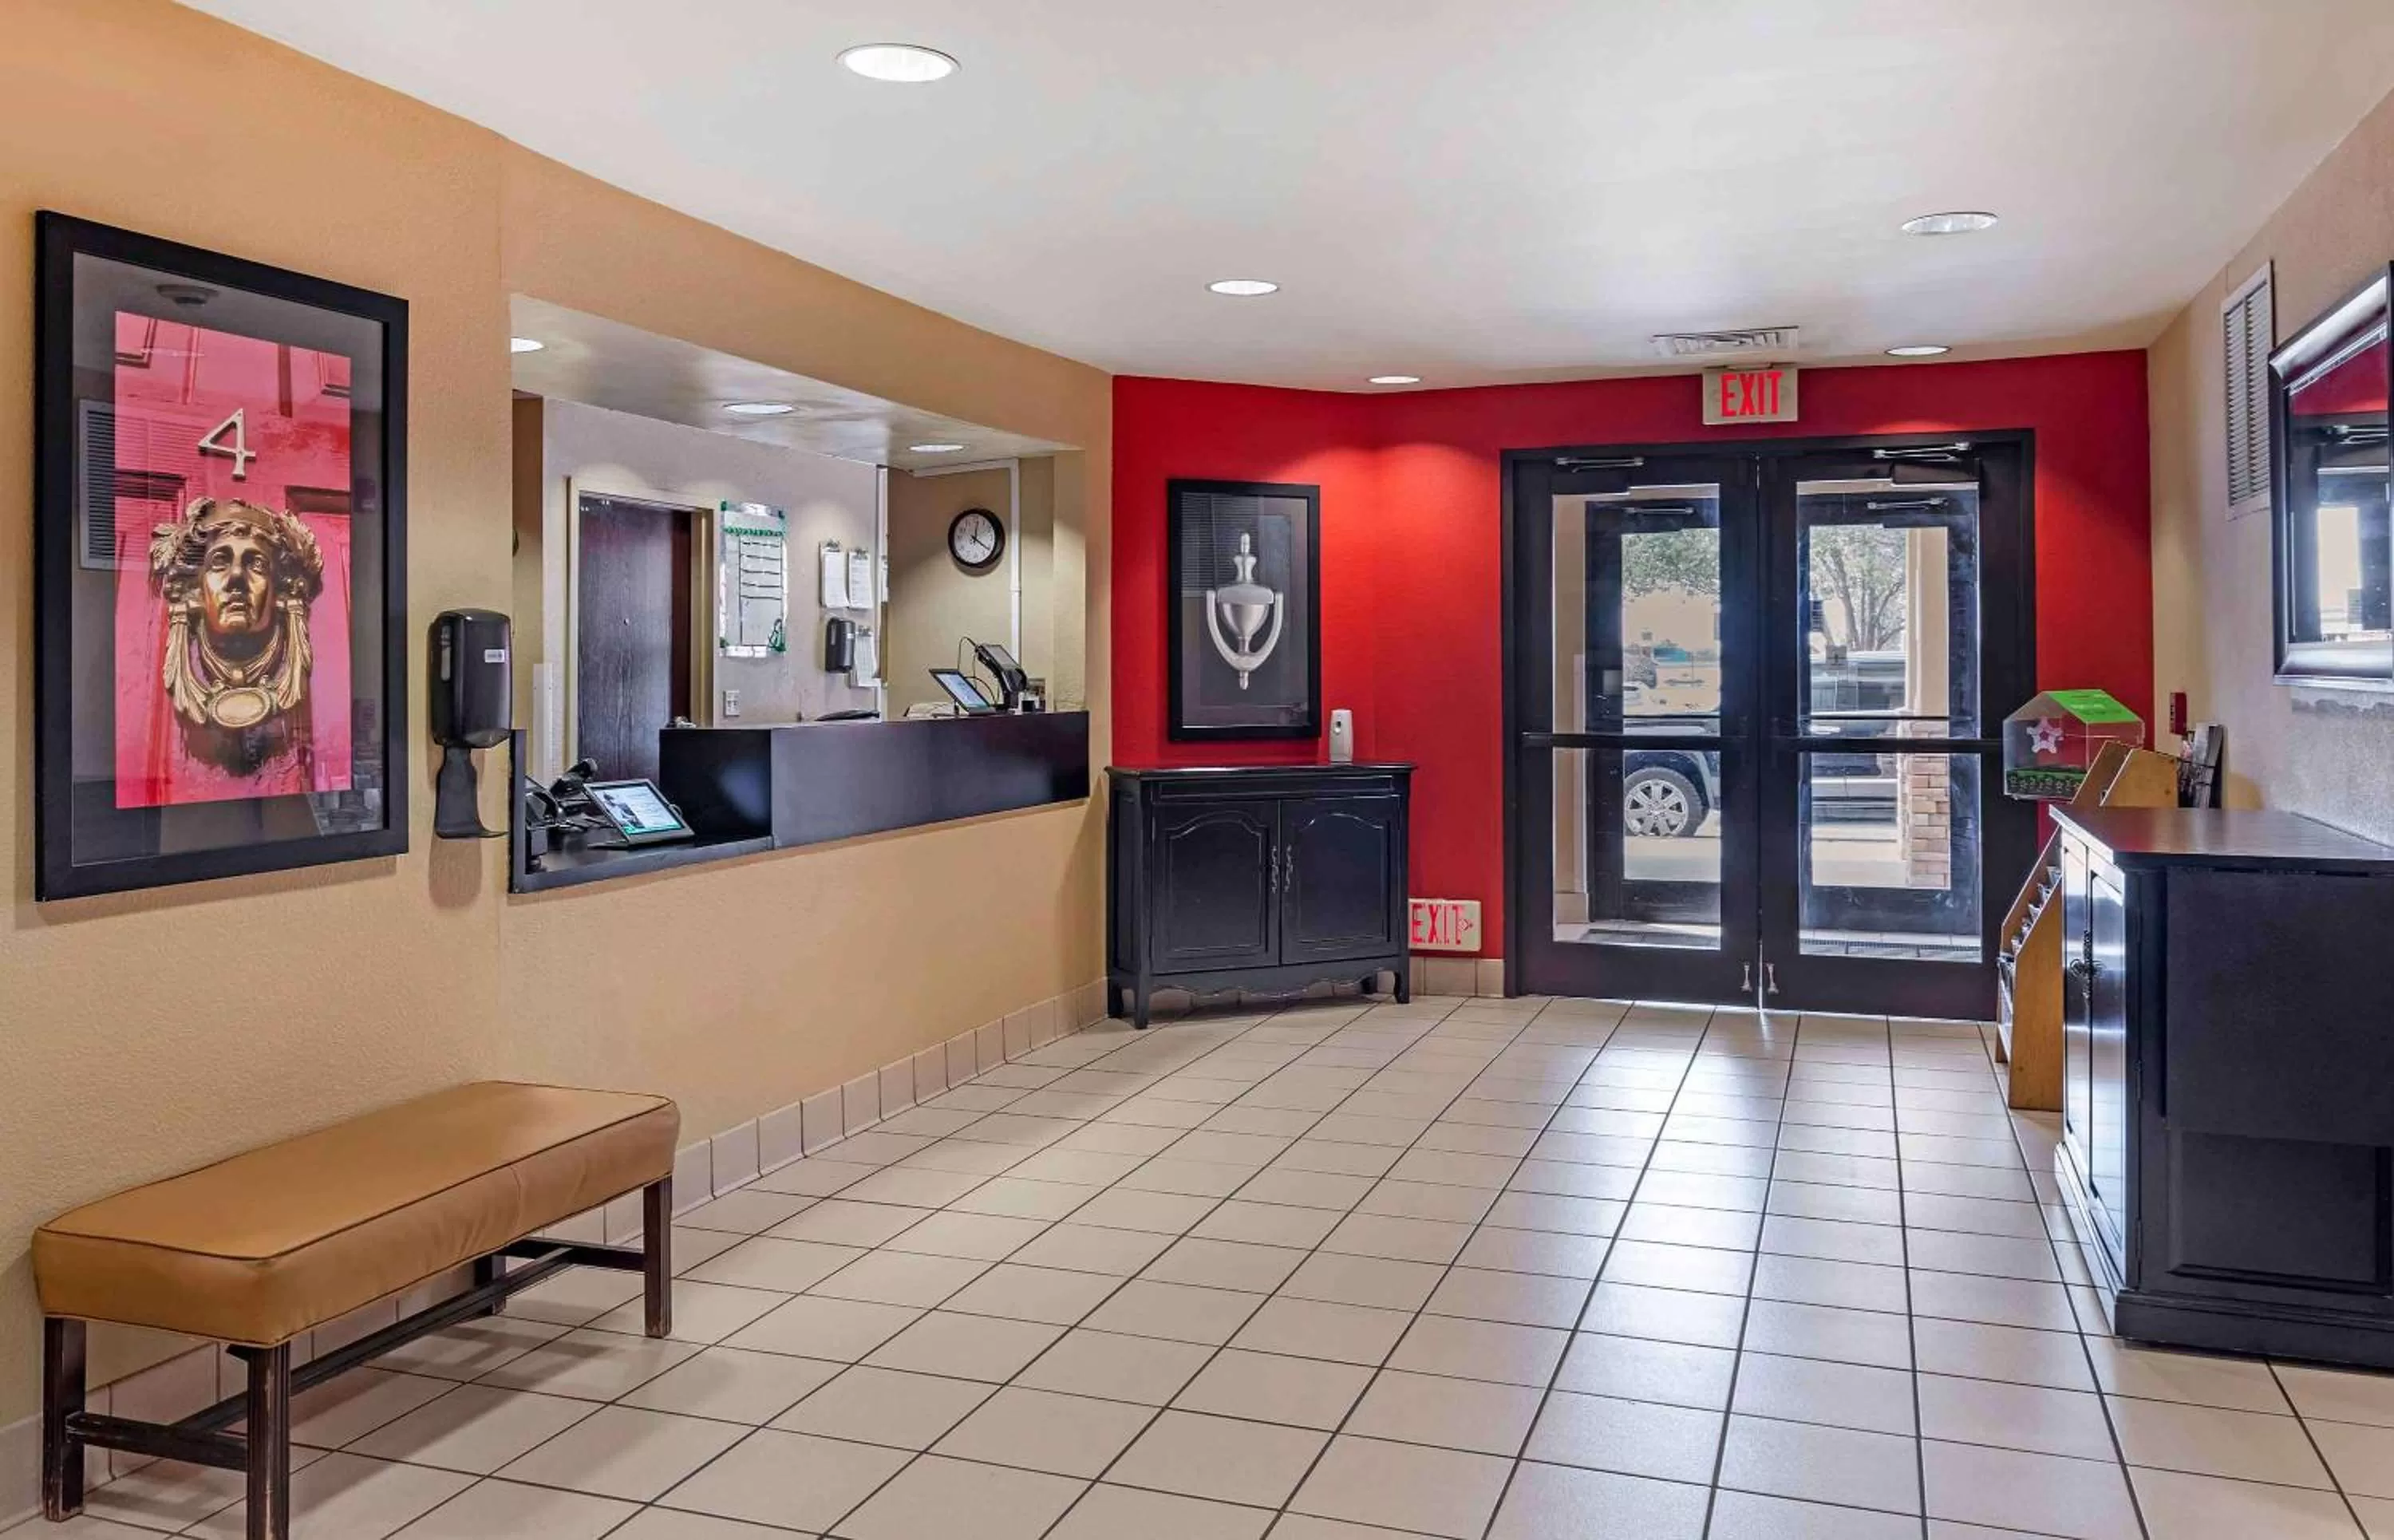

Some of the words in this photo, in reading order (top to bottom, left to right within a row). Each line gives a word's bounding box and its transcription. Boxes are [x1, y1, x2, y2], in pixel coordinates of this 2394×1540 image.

[1720, 372, 1783, 417] EXIT
[198, 408, 256, 480] 4
[1410, 902, 1465, 946] EXIT
